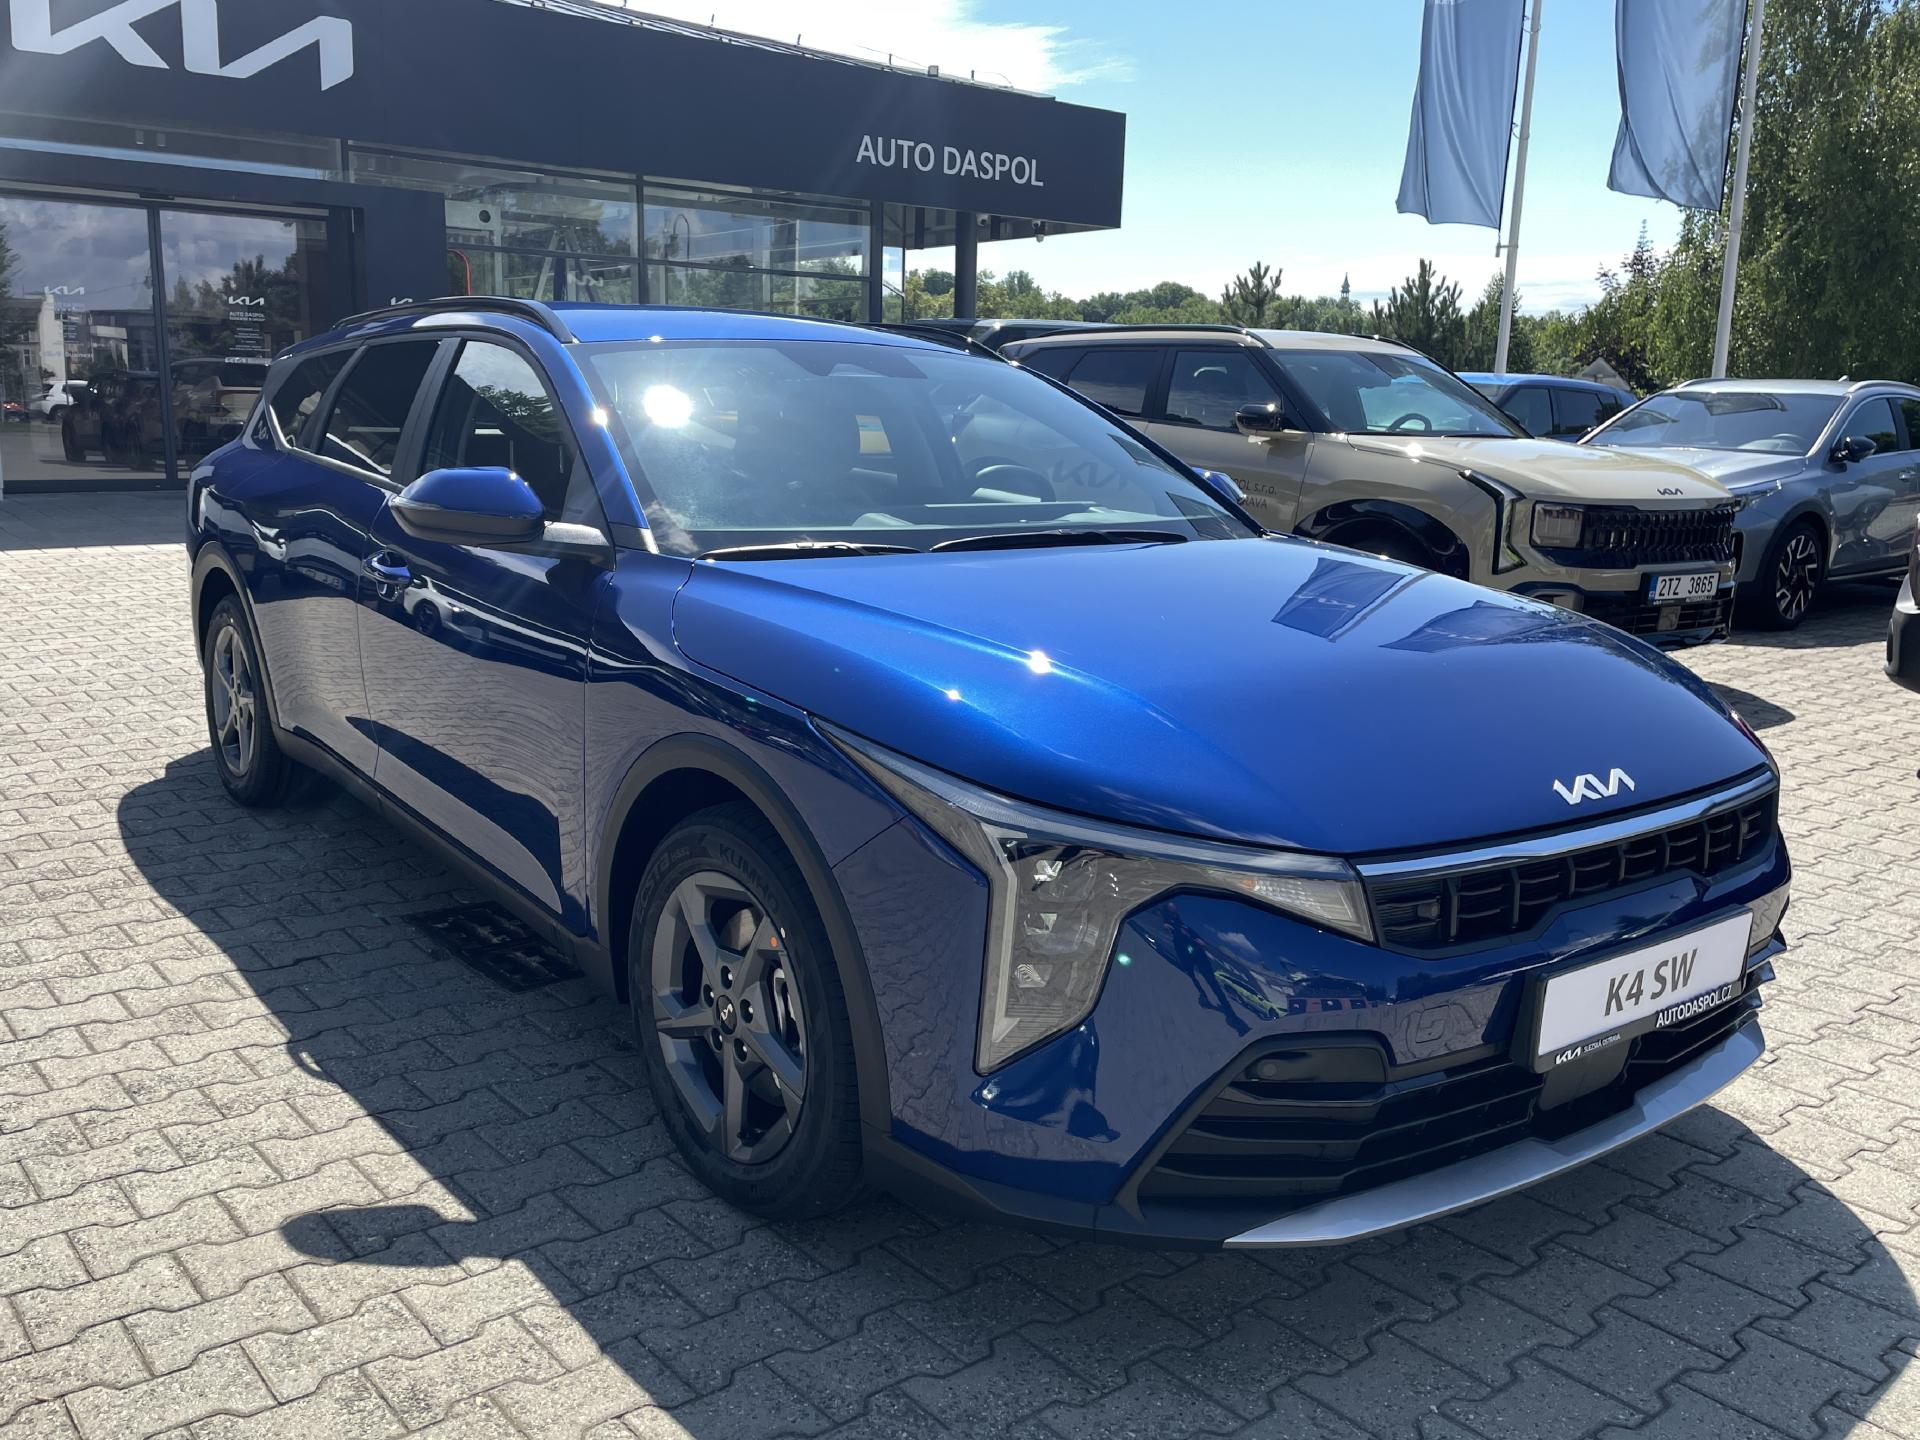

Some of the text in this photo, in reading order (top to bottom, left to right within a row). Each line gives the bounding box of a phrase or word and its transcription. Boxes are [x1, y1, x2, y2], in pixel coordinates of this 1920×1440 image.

[855, 134, 1044, 187] AUTO DASPOL
[228, 296, 265, 306] KIA
[1658, 575, 1715, 597] 2TZ 3865
[1552, 767, 1636, 806] KIA
[1604, 948, 1698, 1017] K4 SW
[1655, 984, 1733, 1028] AUTODASPOL.CZ
[1555, 1046, 1582, 1065] KIA
